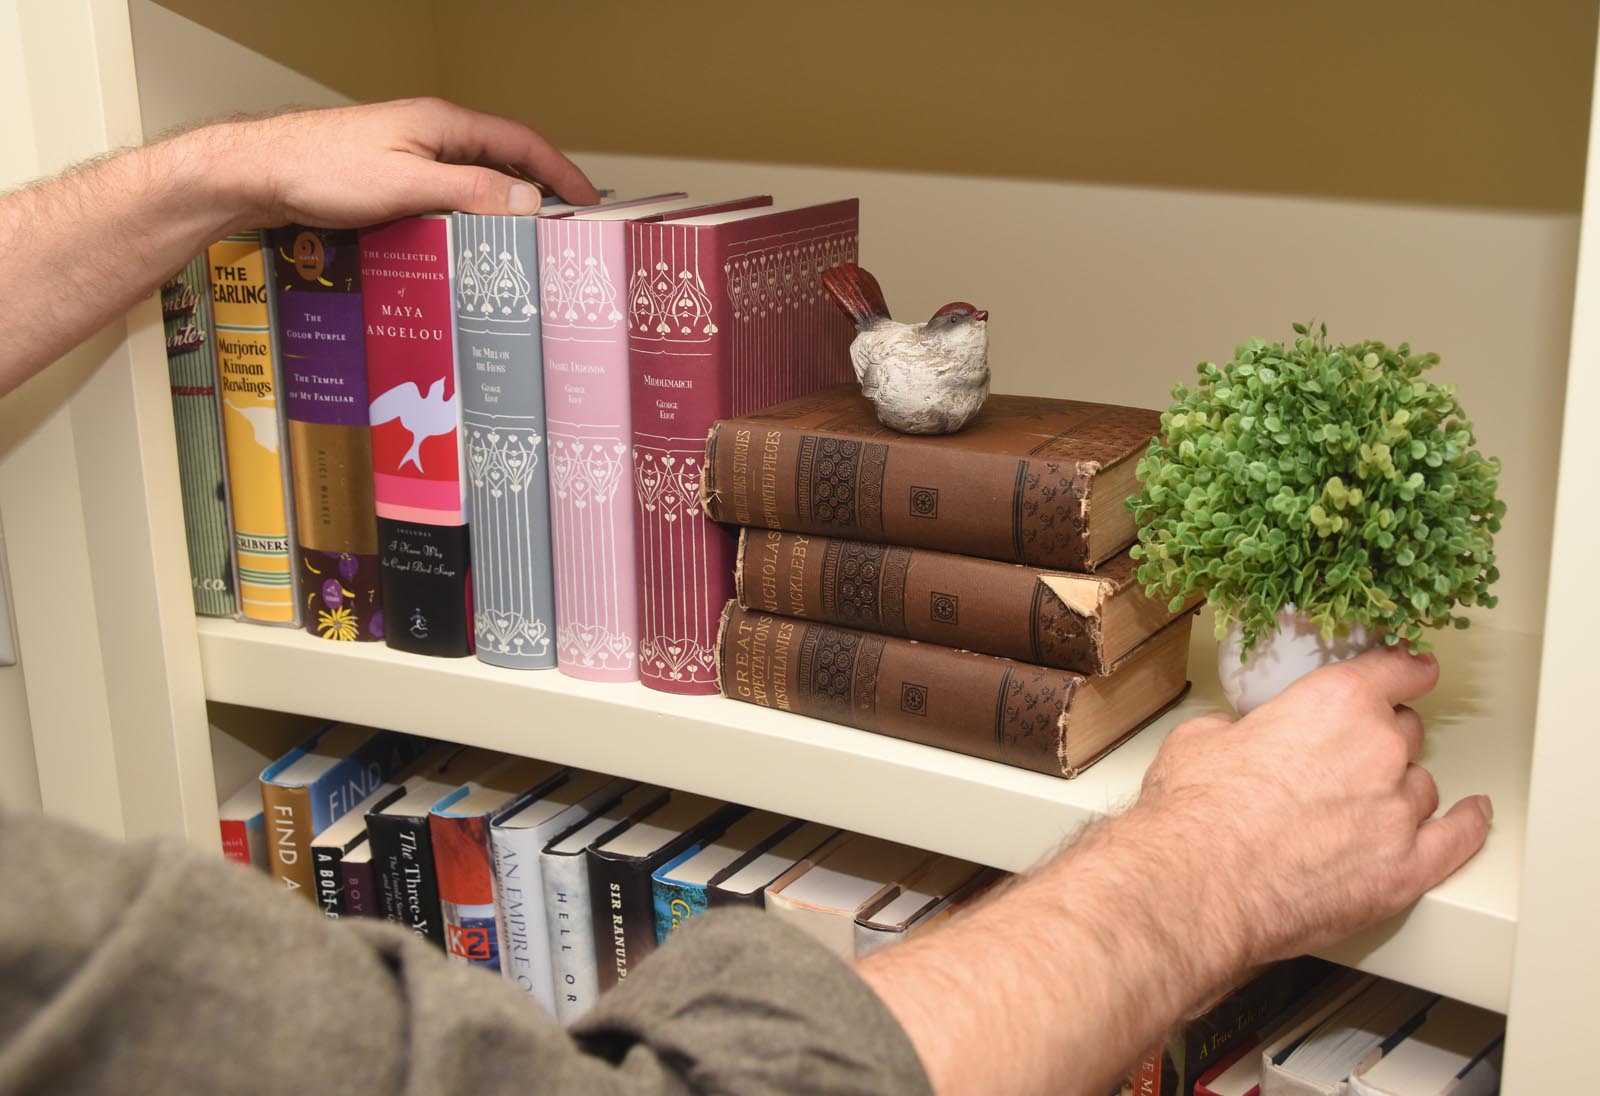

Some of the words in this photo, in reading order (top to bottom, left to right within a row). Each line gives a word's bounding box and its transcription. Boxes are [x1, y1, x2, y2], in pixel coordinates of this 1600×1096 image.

[364, 250, 379, 258] THE
[383, 251, 437, 262] COLLECTED
[215, 266, 247, 281] THE
[213, 284, 268, 304] EARLING
[397, 288, 405, 298] of
[304, 313, 322, 322] THE
[382, 304, 423, 318] MAYA
[167, 323, 206, 347] unter
[286, 329, 312, 340] COLOR
[314, 331, 347, 341] PURPLE
[367, 325, 443, 341] ANGELOU
[219, 338, 267, 359] Marjorie
[224, 358, 264, 375] Kinnan
[223, 376, 272, 398] Rawlings
[293, 373, 309, 383] THE
[312, 374, 344, 385] TEMPLE
[643, 374, 692, 389] MIDDLEMARCH
[299, 390, 312, 400] MY
[314, 391, 355, 403] FAMILIAR
[733, 430, 751, 473] STORIES
[763, 431, 782, 472] PIECES
[762, 473, 781, 529] REPRINTED
[237, 537, 289, 551] RIBNERS
[762, 531, 782, 613] NICHOLAS
[789, 535, 809, 617] NICKLEBY
[736, 620, 753, 697] GREAT
[751, 616, 773, 707] EXPECTATIONS
[773, 621, 794, 711] MISCELLANIES
[273, 805, 298, 865] FIND
[400, 831, 417, 860] The
[317, 854, 333, 862] A
[502, 848, 521, 880] AN
[281, 874, 301, 891] A
[320, 869, 338, 905] BOLT
[610, 882, 623, 909] SIR
[506, 887, 530, 969] EMPIRE
[449, 926, 488, 957] K2
[556, 892, 572, 952] HELL
[565, 973, 577, 1003] OR
